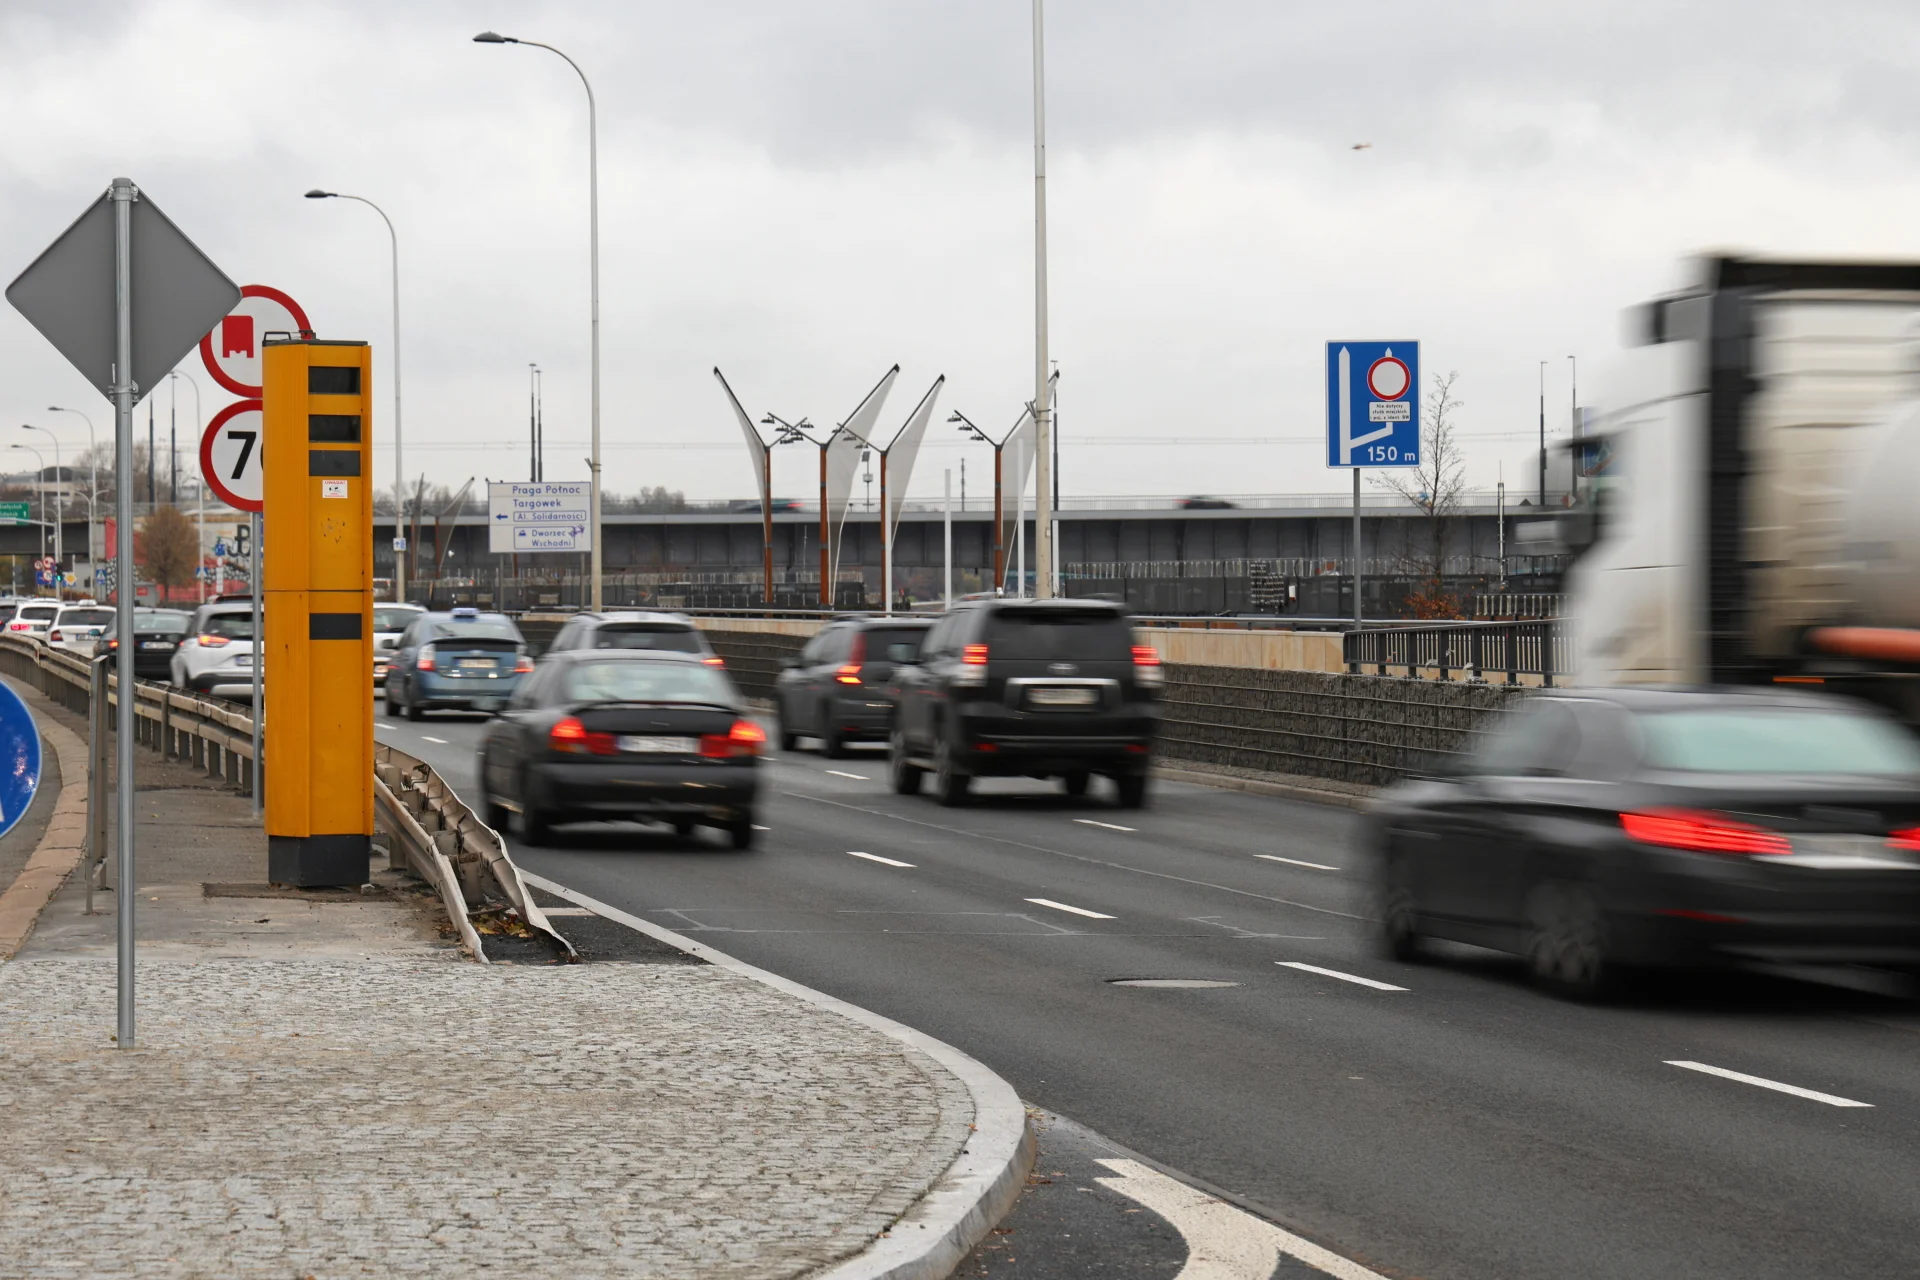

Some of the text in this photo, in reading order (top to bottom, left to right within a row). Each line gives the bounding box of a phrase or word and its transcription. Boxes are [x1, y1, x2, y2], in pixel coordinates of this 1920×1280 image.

[227, 430, 263, 480] 7
[1368, 446, 1416, 461] 150 m
[512, 485, 542, 496] Praga
[531, 529, 566, 537] Dworzec
[531, 539, 571, 547] Wschodni
